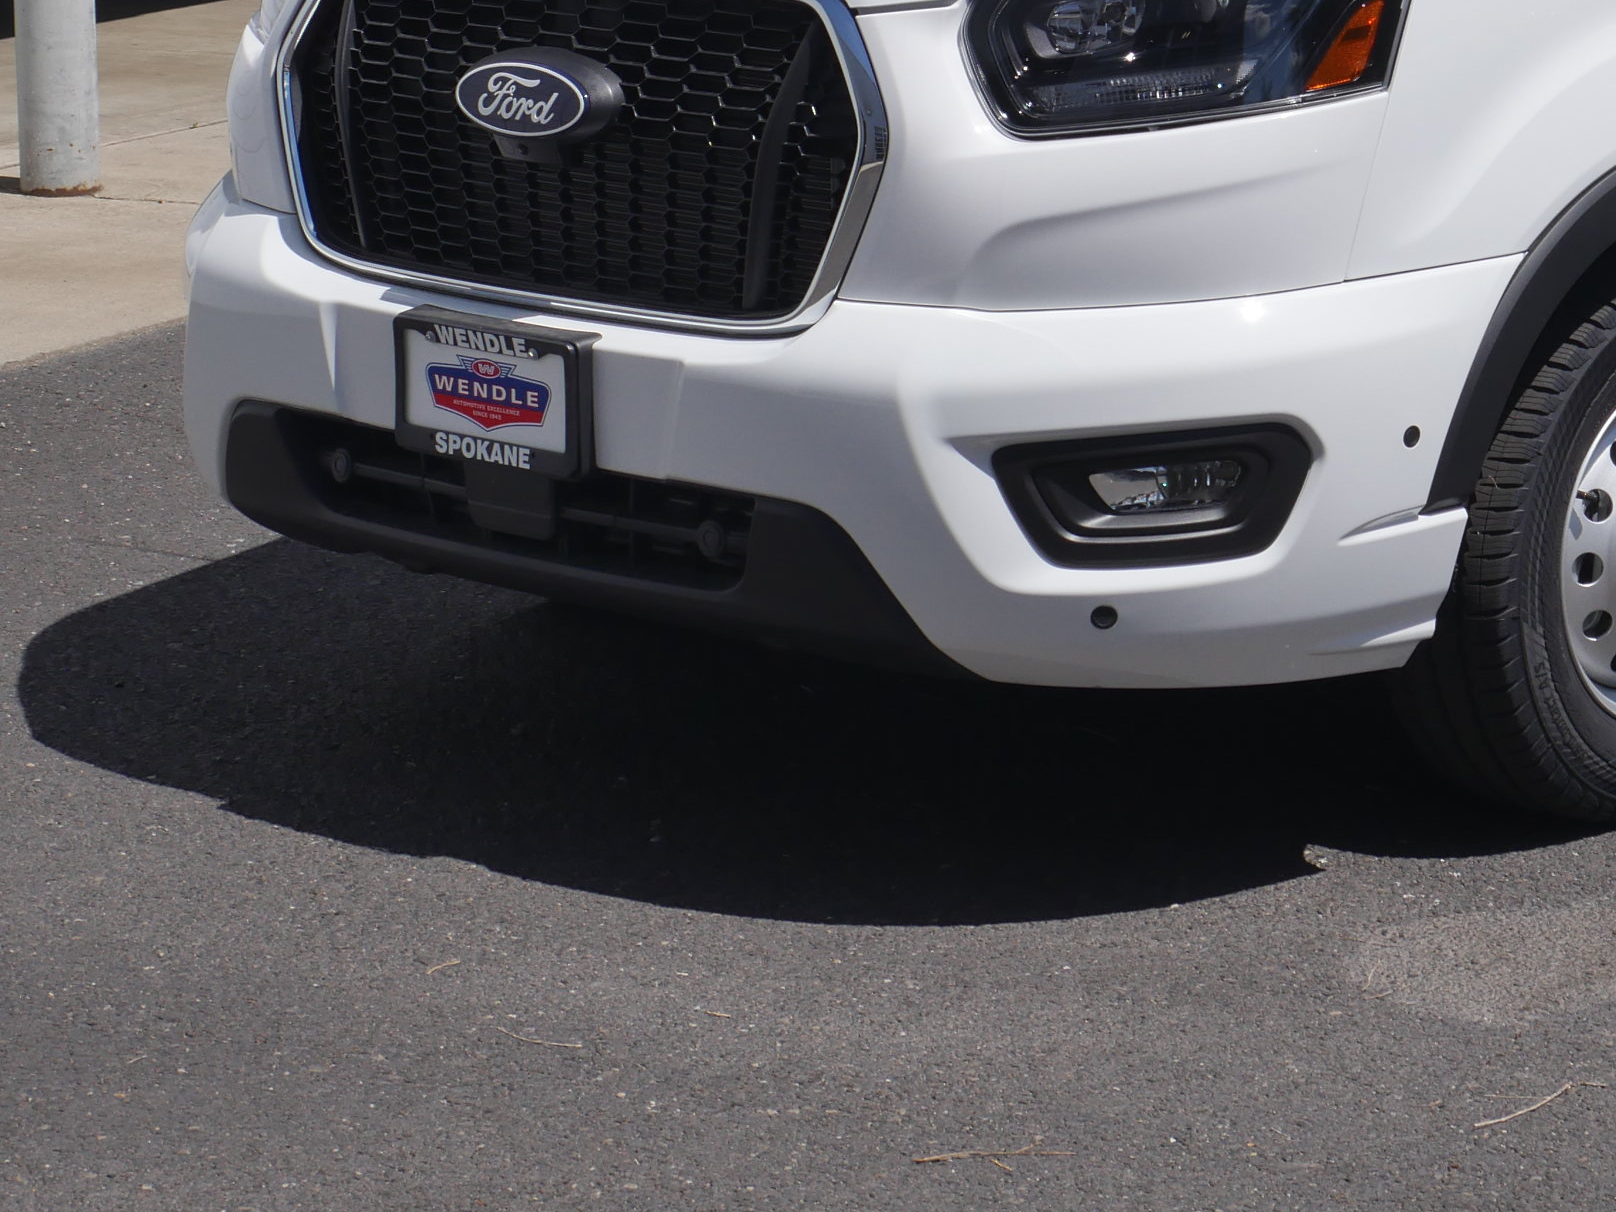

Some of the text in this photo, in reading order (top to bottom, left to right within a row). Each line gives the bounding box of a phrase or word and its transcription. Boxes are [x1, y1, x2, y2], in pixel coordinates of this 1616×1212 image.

[477, 72, 559, 124] Ford
[433, 324, 529, 358] WENDLE
[434, 374, 539, 408] WENDLE
[453, 399, 520, 417] AUTOMOTIVE EXCELLENCE
[473, 410, 488, 419] SINCE
[435, 431, 531, 470] SPOKANE
